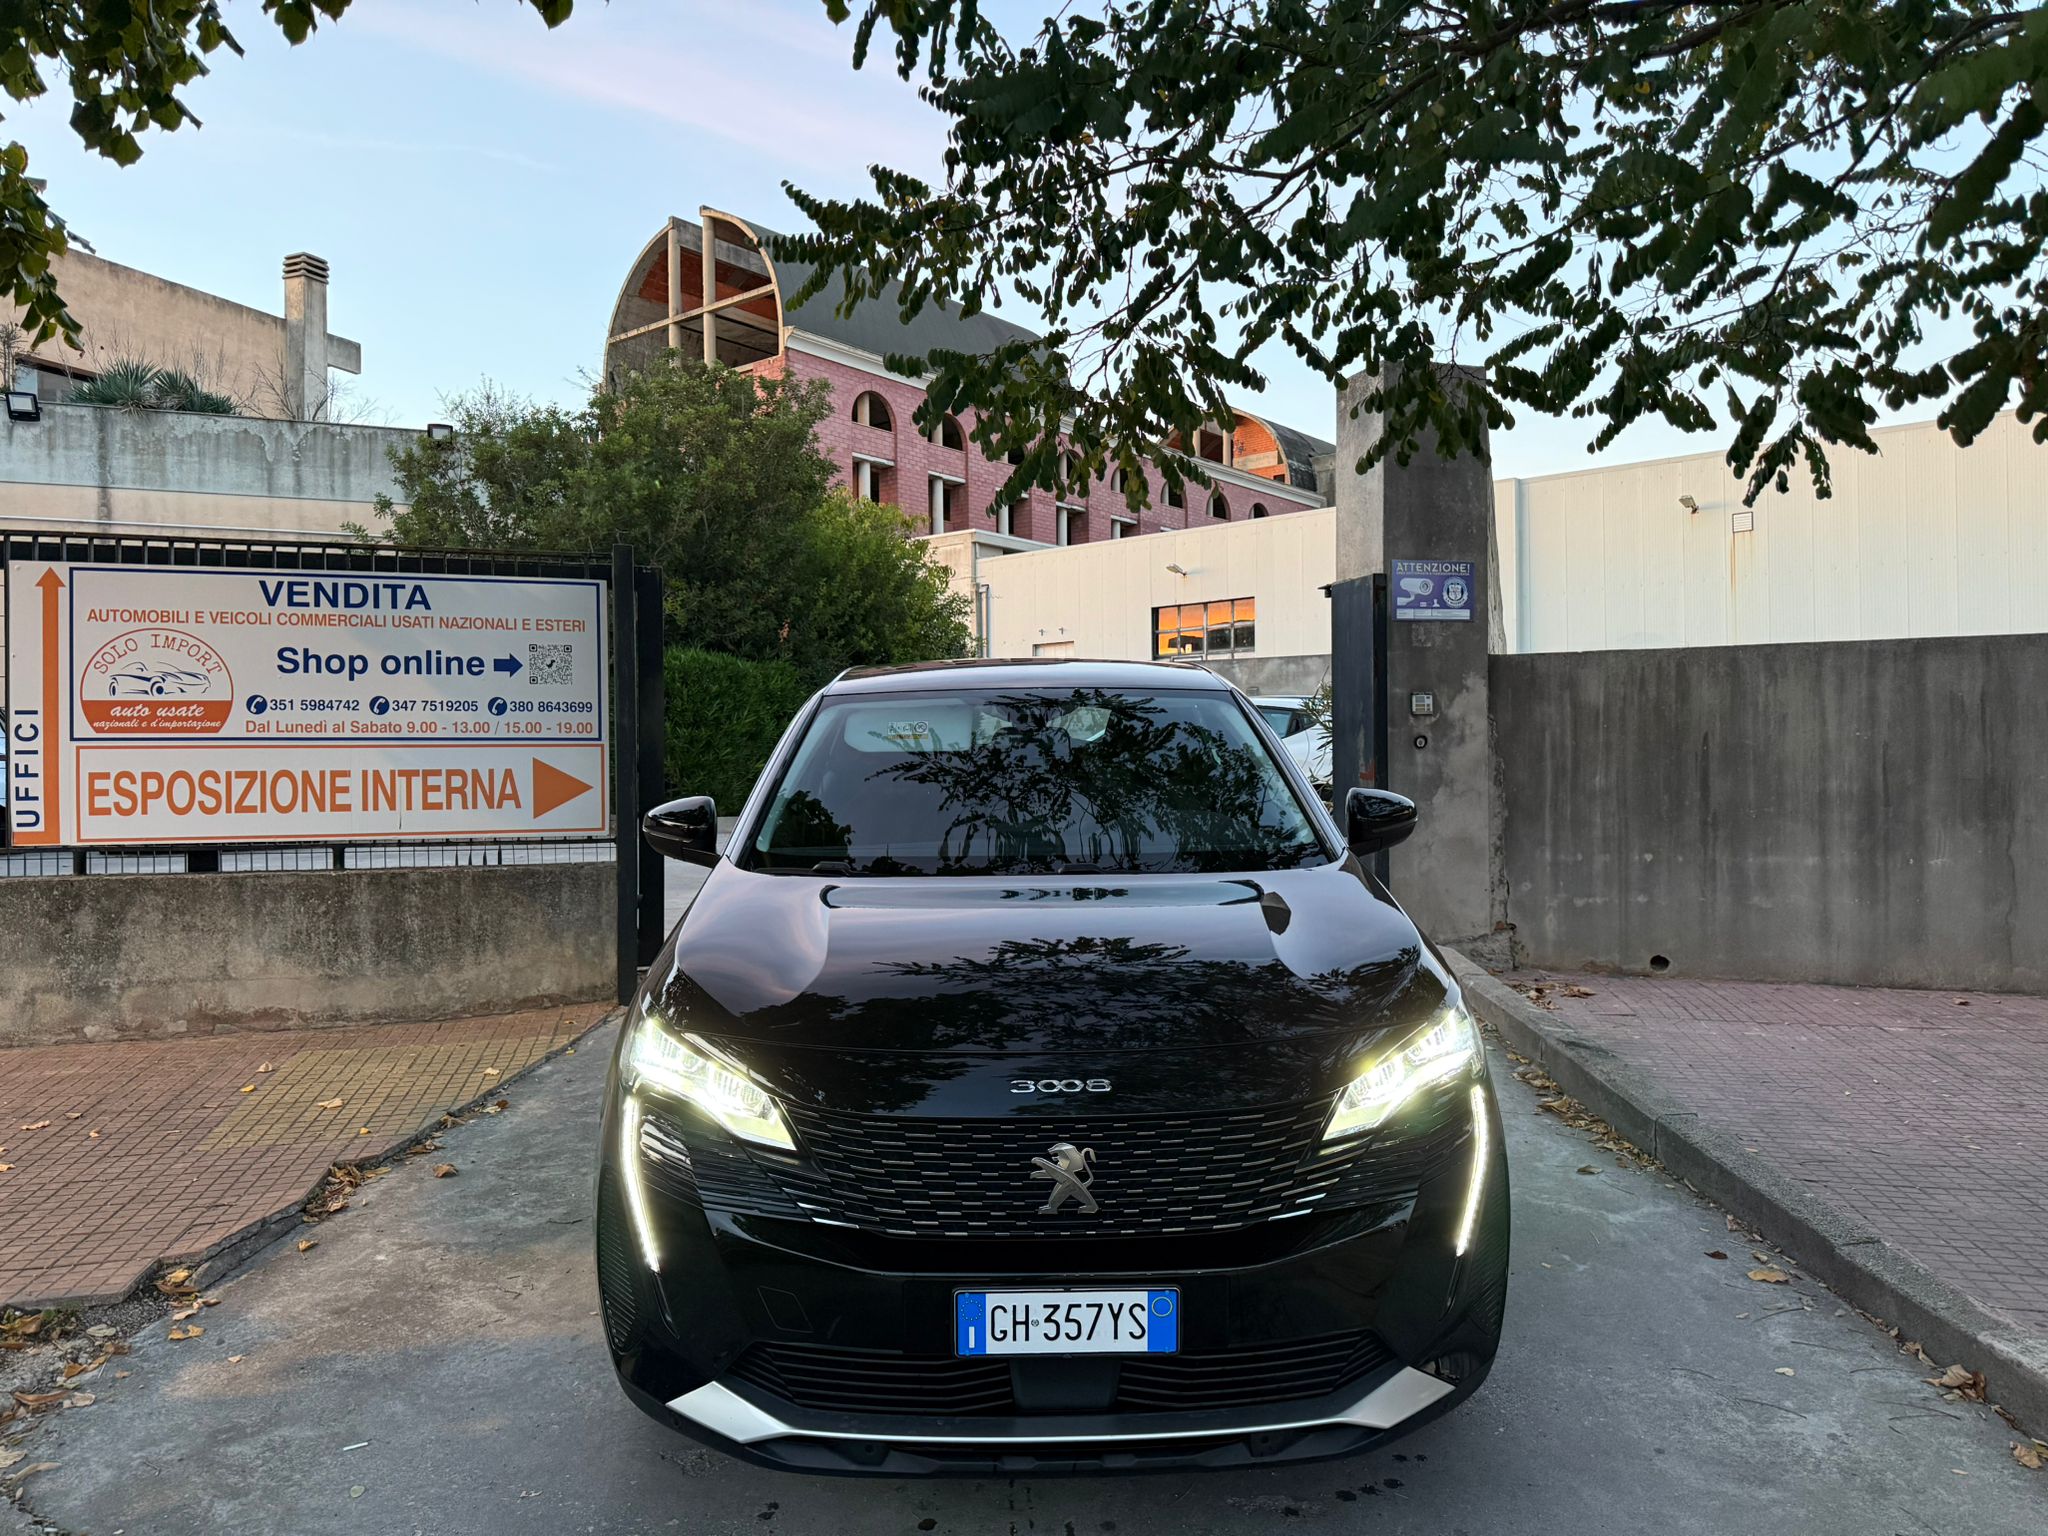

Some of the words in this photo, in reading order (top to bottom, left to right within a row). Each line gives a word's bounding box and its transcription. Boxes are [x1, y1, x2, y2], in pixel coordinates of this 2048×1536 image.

[1396, 562, 1471, 574] ATTENZIONE!
[258, 579, 432, 611] VENDITA
[87, 608, 189, 624] AUTOMOBILI
[194, 610, 205, 624] E
[209, 610, 272, 626] VEICOLI
[277, 612, 387, 629] COMMERCIALI
[391, 614, 435, 629] USATI
[439, 616, 518, 631] NAZIONALI
[521, 618, 532, 631] E
[535, 618, 586, 633] ESTERI
[93, 637, 139, 675] SOLO
[150, 633, 223, 675] IMPORT
[276, 646, 369, 681] Shop
[380, 649, 485, 677] online
[110, 703, 151, 717] auto
[156, 703, 206, 717] usate
[269, 698, 295, 712] 351
[300, 699, 360, 712] 5984742
[392, 699, 417, 712] 347
[421, 699, 479, 713] 7519205
[509, 700, 534, 713] 380
[537, 701, 593, 713] 8643699
[93, 718, 140, 730] nazionali
[140, 720, 148, 728] e
[150, 717, 222, 731] d'importazione
[245, 719, 271, 734] Dal
[275, 720, 327, 734] Lunedì
[332, 720, 346, 734] al
[350, 720, 403, 734] Sabato
[406, 721, 438, 734] 9.00
[451, 721, 491, 734] 13.00
[504, 721, 543, 734] 15.00
[555, 721, 593, 735] 19.00
[13, 708, 41, 828] UFFICI
[87, 769, 352, 817] ESPOSIZIONE
[361, 768, 522, 812] INTERNA
[1009, 1078, 1112, 1093] 3008
